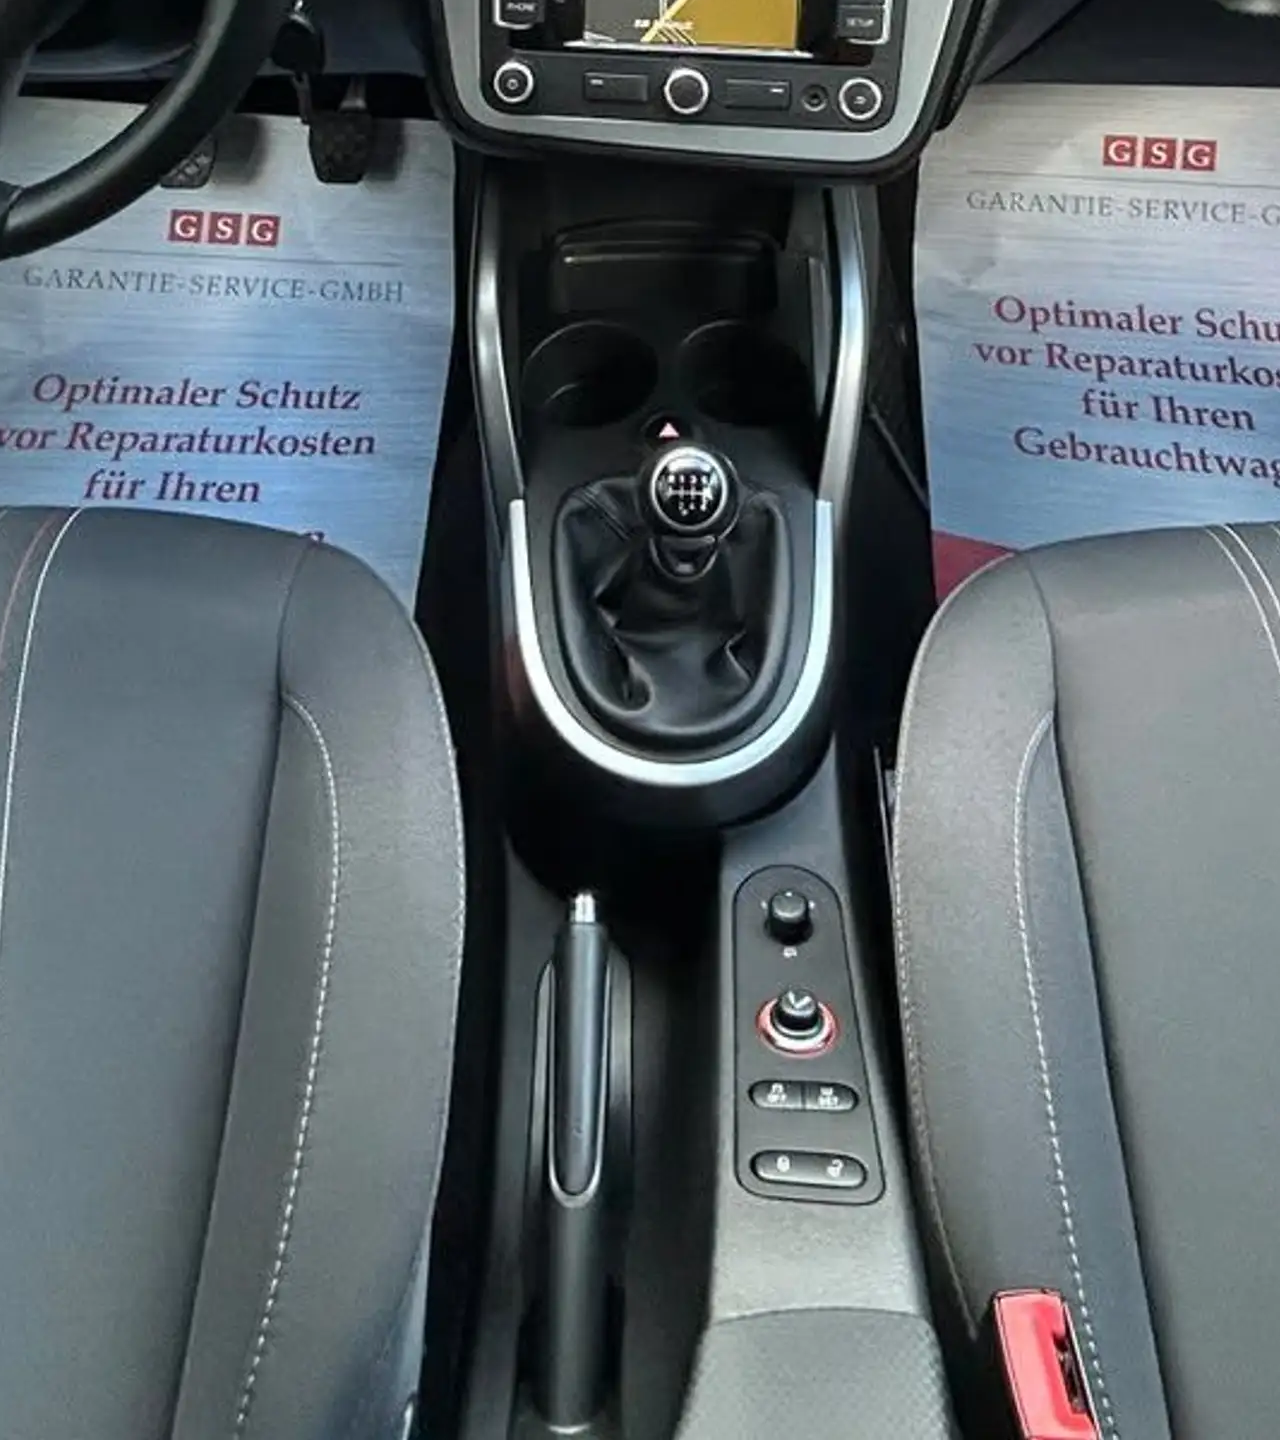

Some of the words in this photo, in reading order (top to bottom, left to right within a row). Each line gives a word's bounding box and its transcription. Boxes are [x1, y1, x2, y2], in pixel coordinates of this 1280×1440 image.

[1105, 137, 1215, 169] GSG
[171, 211, 278, 245] GSG
[22, 265, 404, 304] GARANTIE-SERVICE-GMBH
[993, 294, 1183, 338] Optimaler
[974, 341, 1033, 367] vor
[32, 372, 227, 412] Optimaler
[235, 379, 362, 412] Schutz
[1081, 390, 1140, 421] für
[1151, 395, 1256, 432] Ihren
[65, 421, 376, 461] Reparaturkosten
[82, 468, 145, 502] für
[153, 470, 261, 504] Ihren
